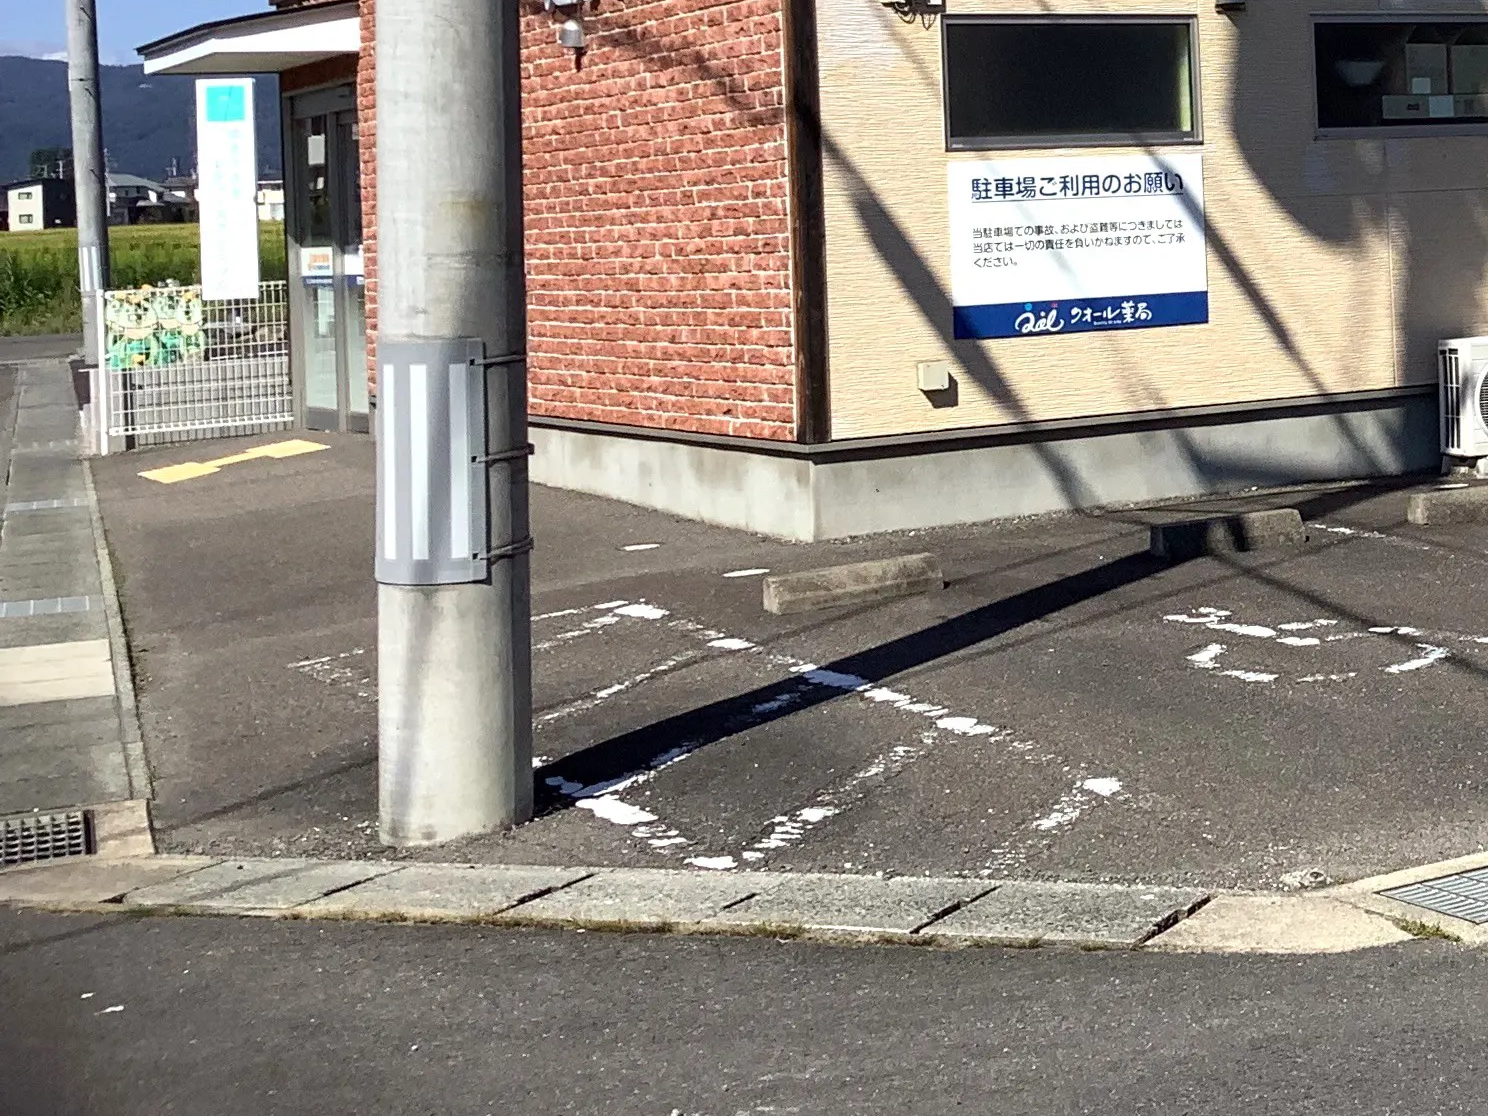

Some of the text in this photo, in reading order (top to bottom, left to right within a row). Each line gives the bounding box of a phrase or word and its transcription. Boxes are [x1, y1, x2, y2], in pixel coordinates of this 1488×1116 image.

[971, 172, 1183, 199] 駐車場ご利用のお願い
[973, 255, 1018, 268] ください。
[1070, 300, 1152, 324] クオール薬局
